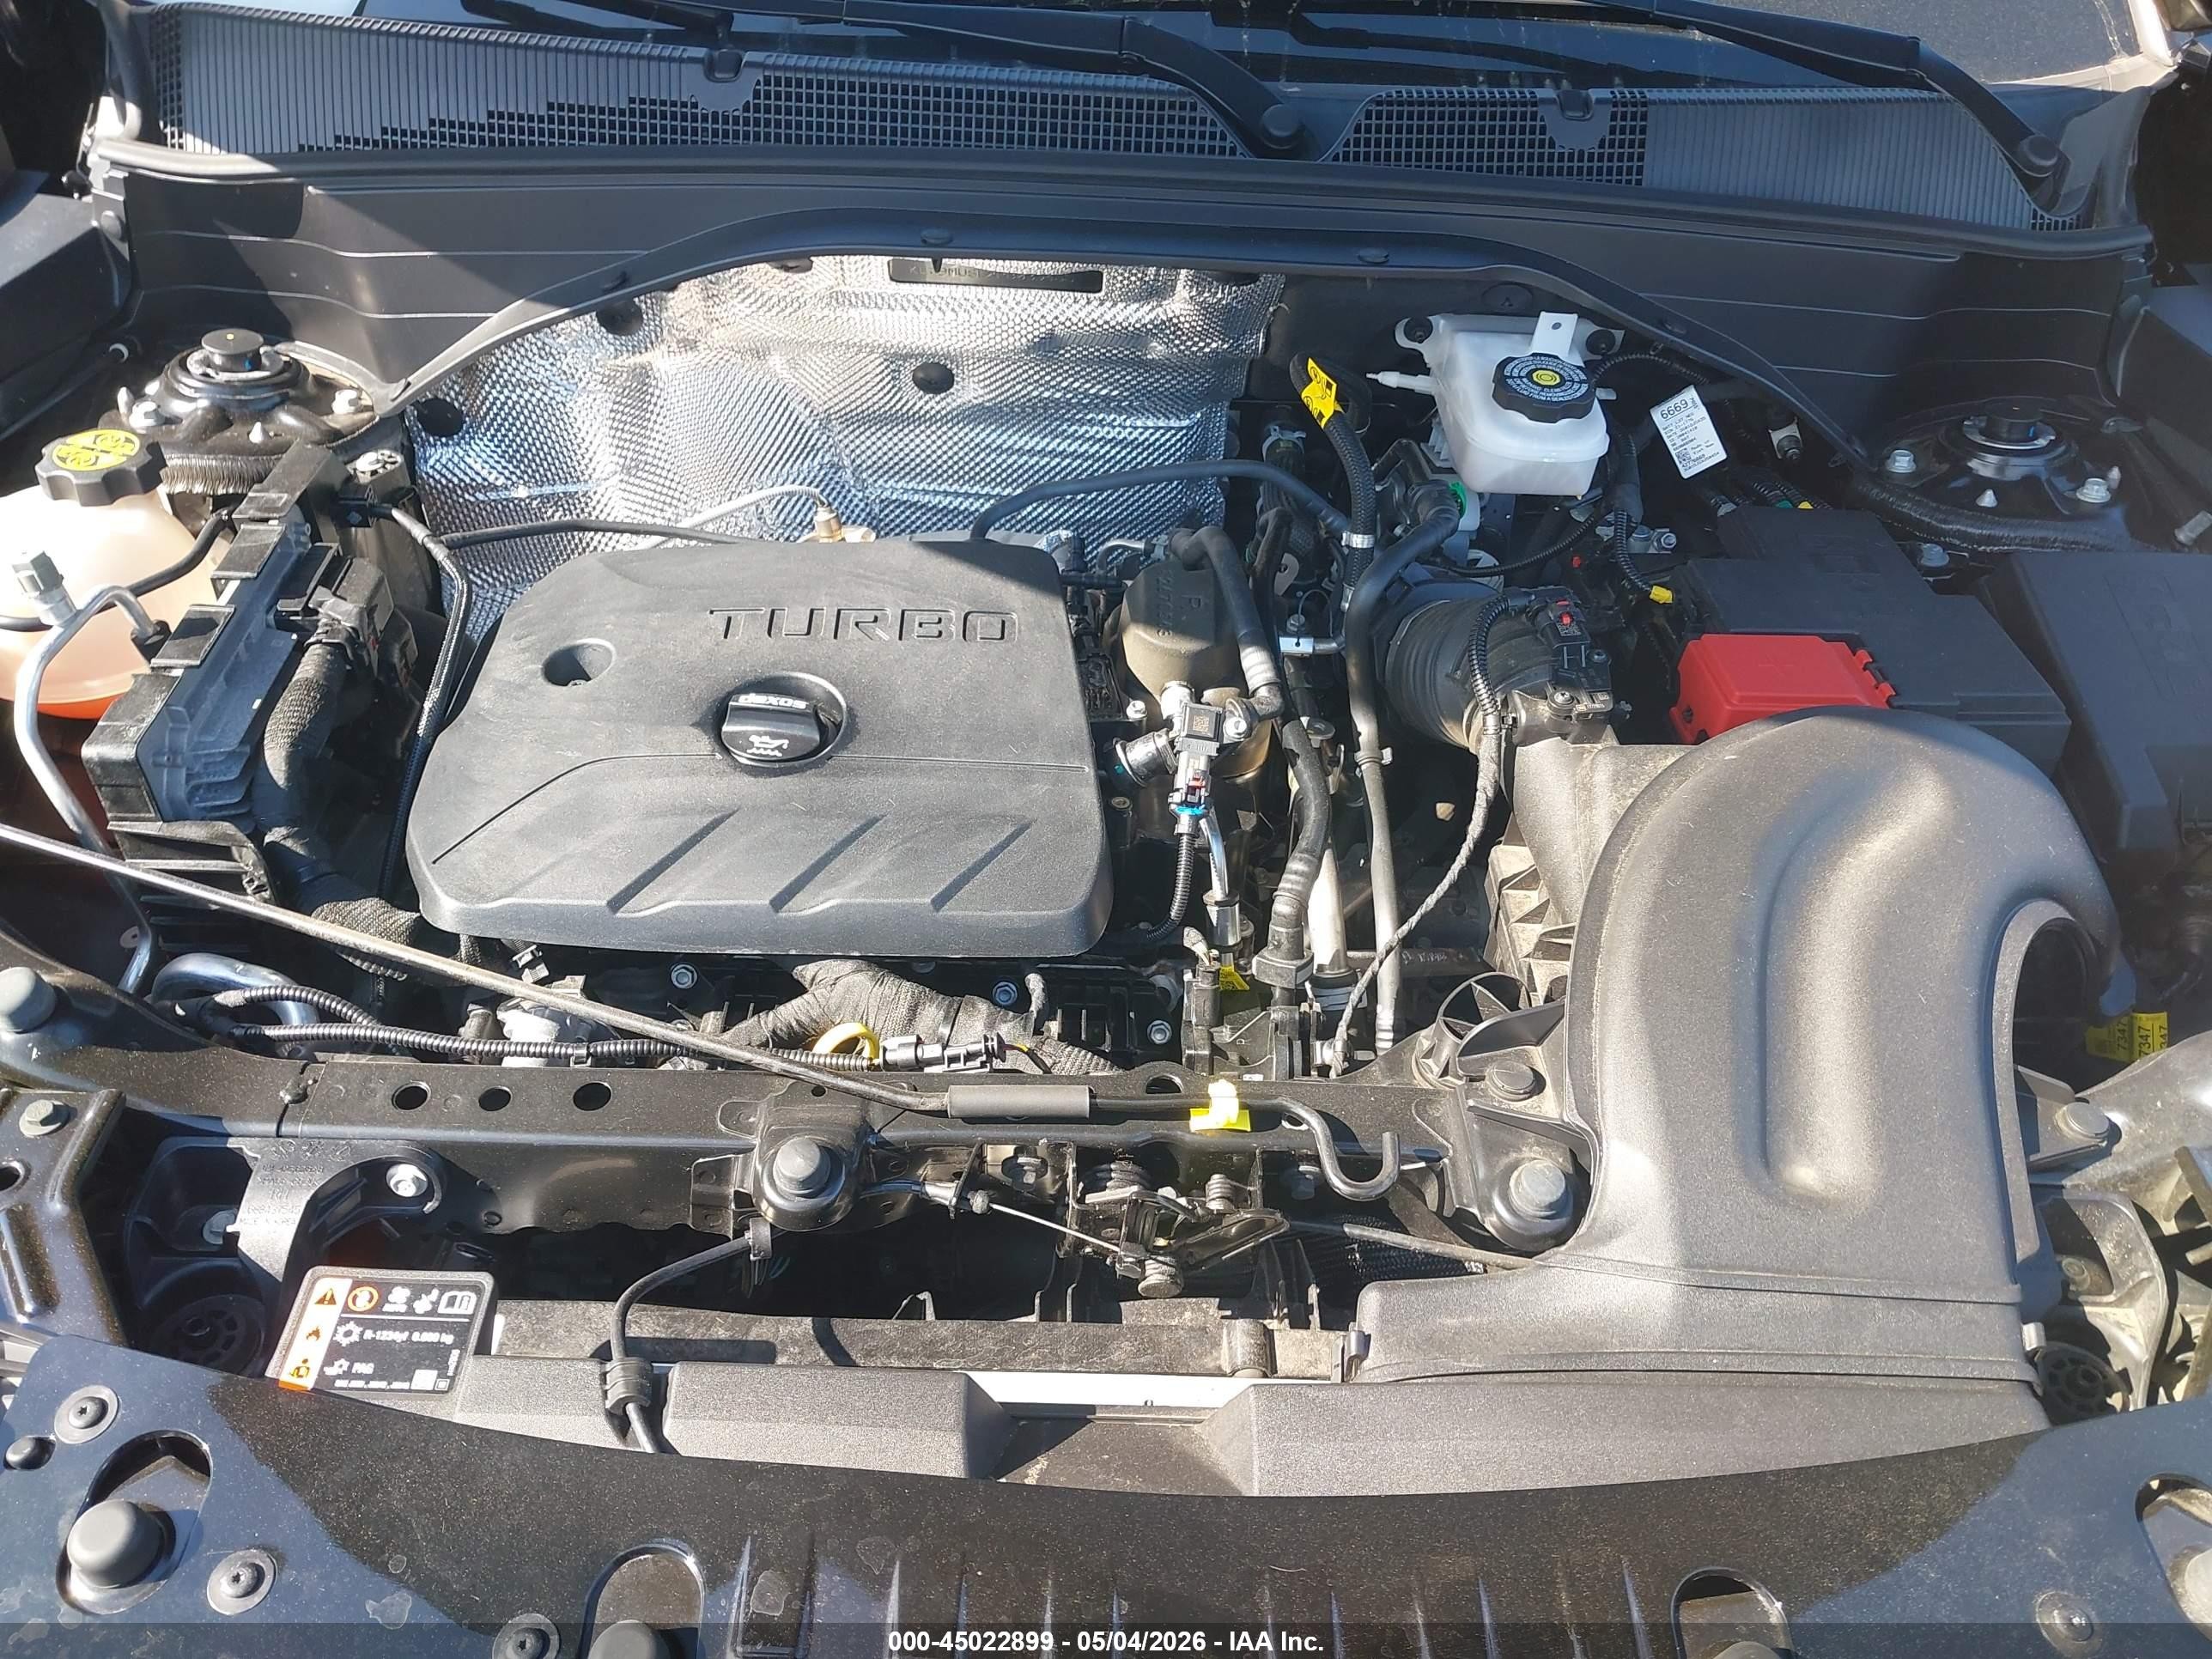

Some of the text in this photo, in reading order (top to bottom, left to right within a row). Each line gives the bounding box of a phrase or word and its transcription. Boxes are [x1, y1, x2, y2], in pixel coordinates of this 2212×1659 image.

[1660, 398, 1689, 420] 6669
[708, 607, 1018, 642] TURBO
[738, 693, 809, 709] dexos
